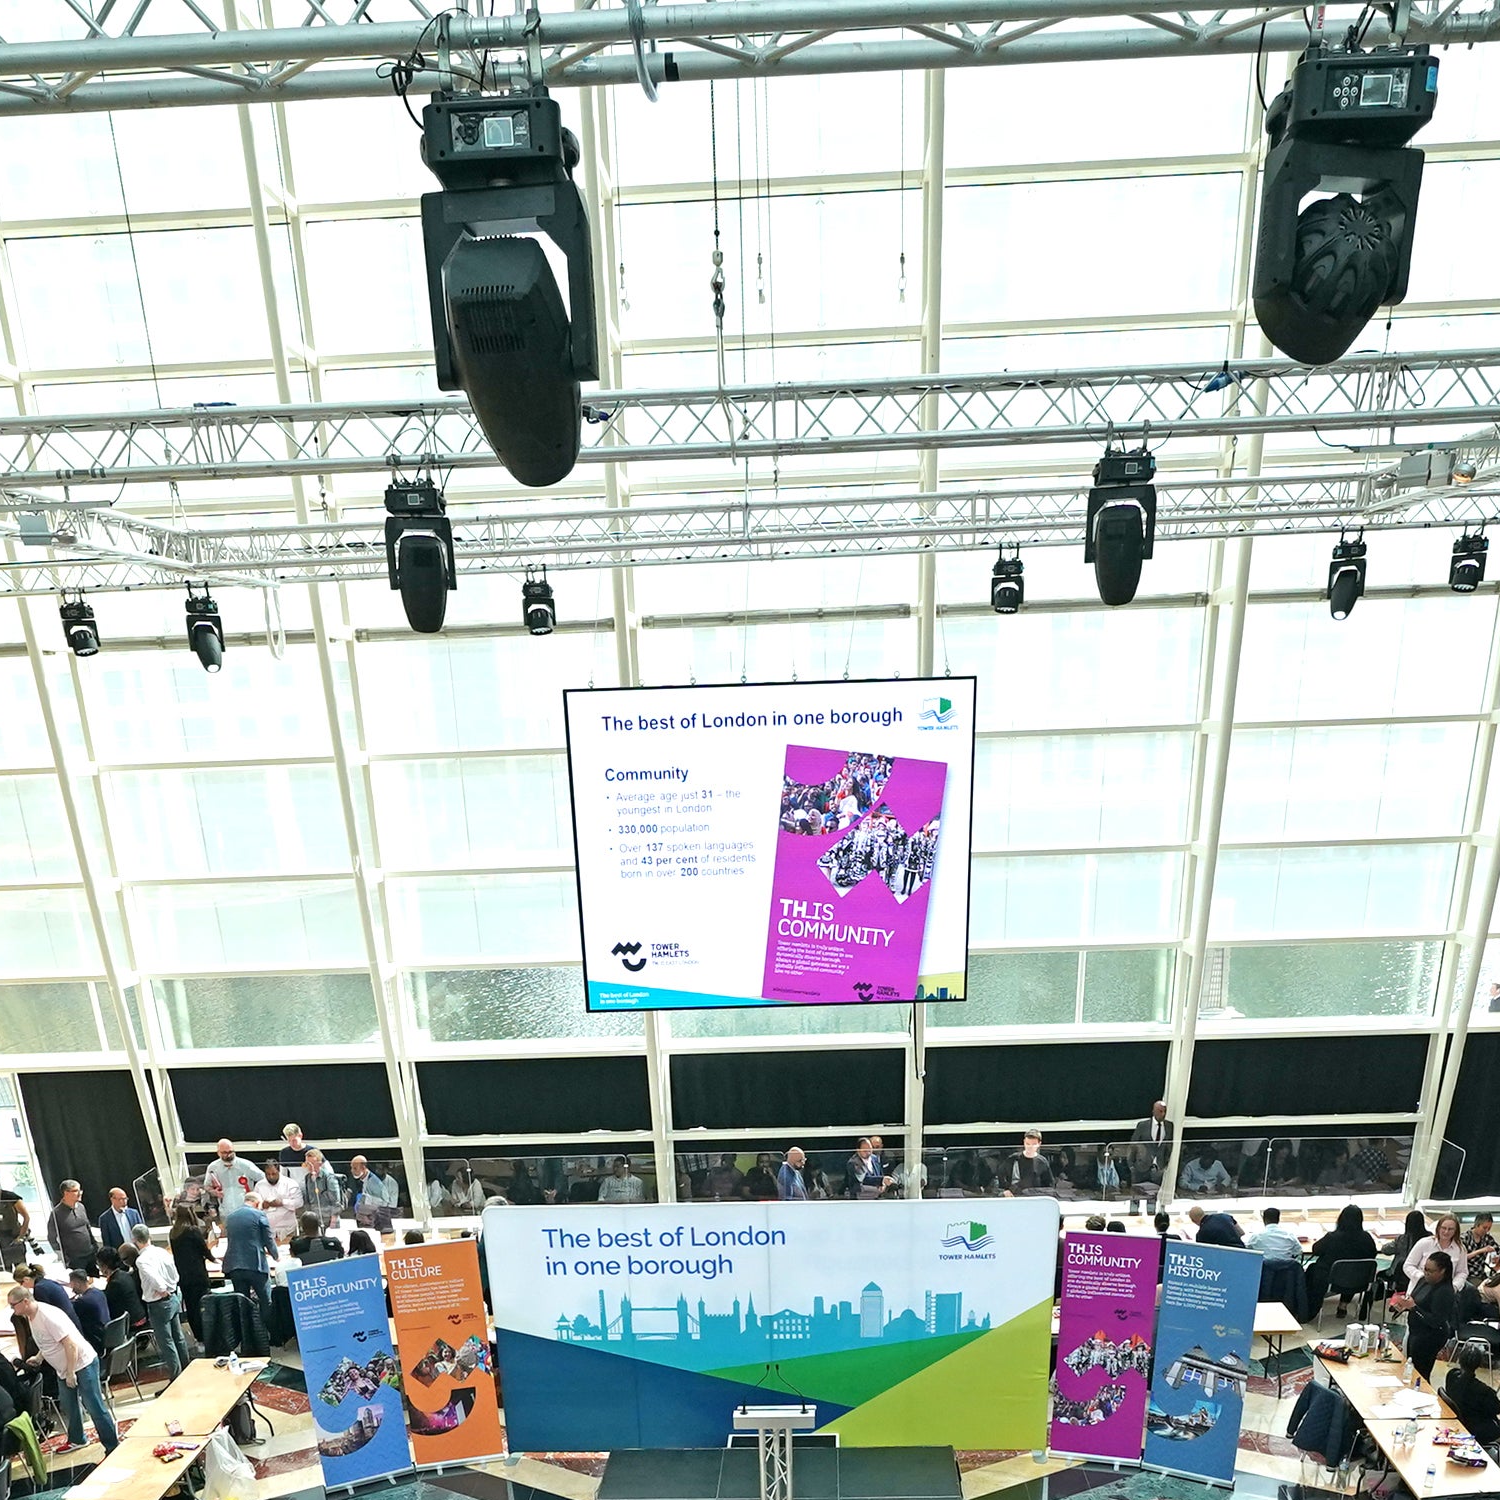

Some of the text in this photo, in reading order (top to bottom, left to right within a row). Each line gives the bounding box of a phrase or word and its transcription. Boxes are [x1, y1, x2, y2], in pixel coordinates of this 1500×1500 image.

[602, 708, 902, 731] The best of London in one borough
[605, 767, 689, 783] Community
[616, 789, 740, 803] Average age just 31 the
[617, 804, 712, 817] youngest in London
[618, 823, 709, 835] 330,000 population
[620, 840, 754, 853] Over 137 spoken languages
[620, 854, 756, 867] and 43 per cent of residents
[621, 870, 642, 878] born
[645, 869, 654, 877] in
[681, 868, 698, 877] 200
[702, 866, 744, 875] countries
[777, 918, 895, 947] COMMUNITY
[651, 950, 689, 958] HAMLETS
[541, 1225, 786, 1249] The best of London
[546, 1254, 733, 1280] in one borough
[1067, 1254, 1141, 1269] COMMUNITY
[391, 1265, 442, 1281] CULTURE
[1168, 1264, 1222, 1282] HISTORY
[294, 1277, 378, 1302] OPPORTUNITY
